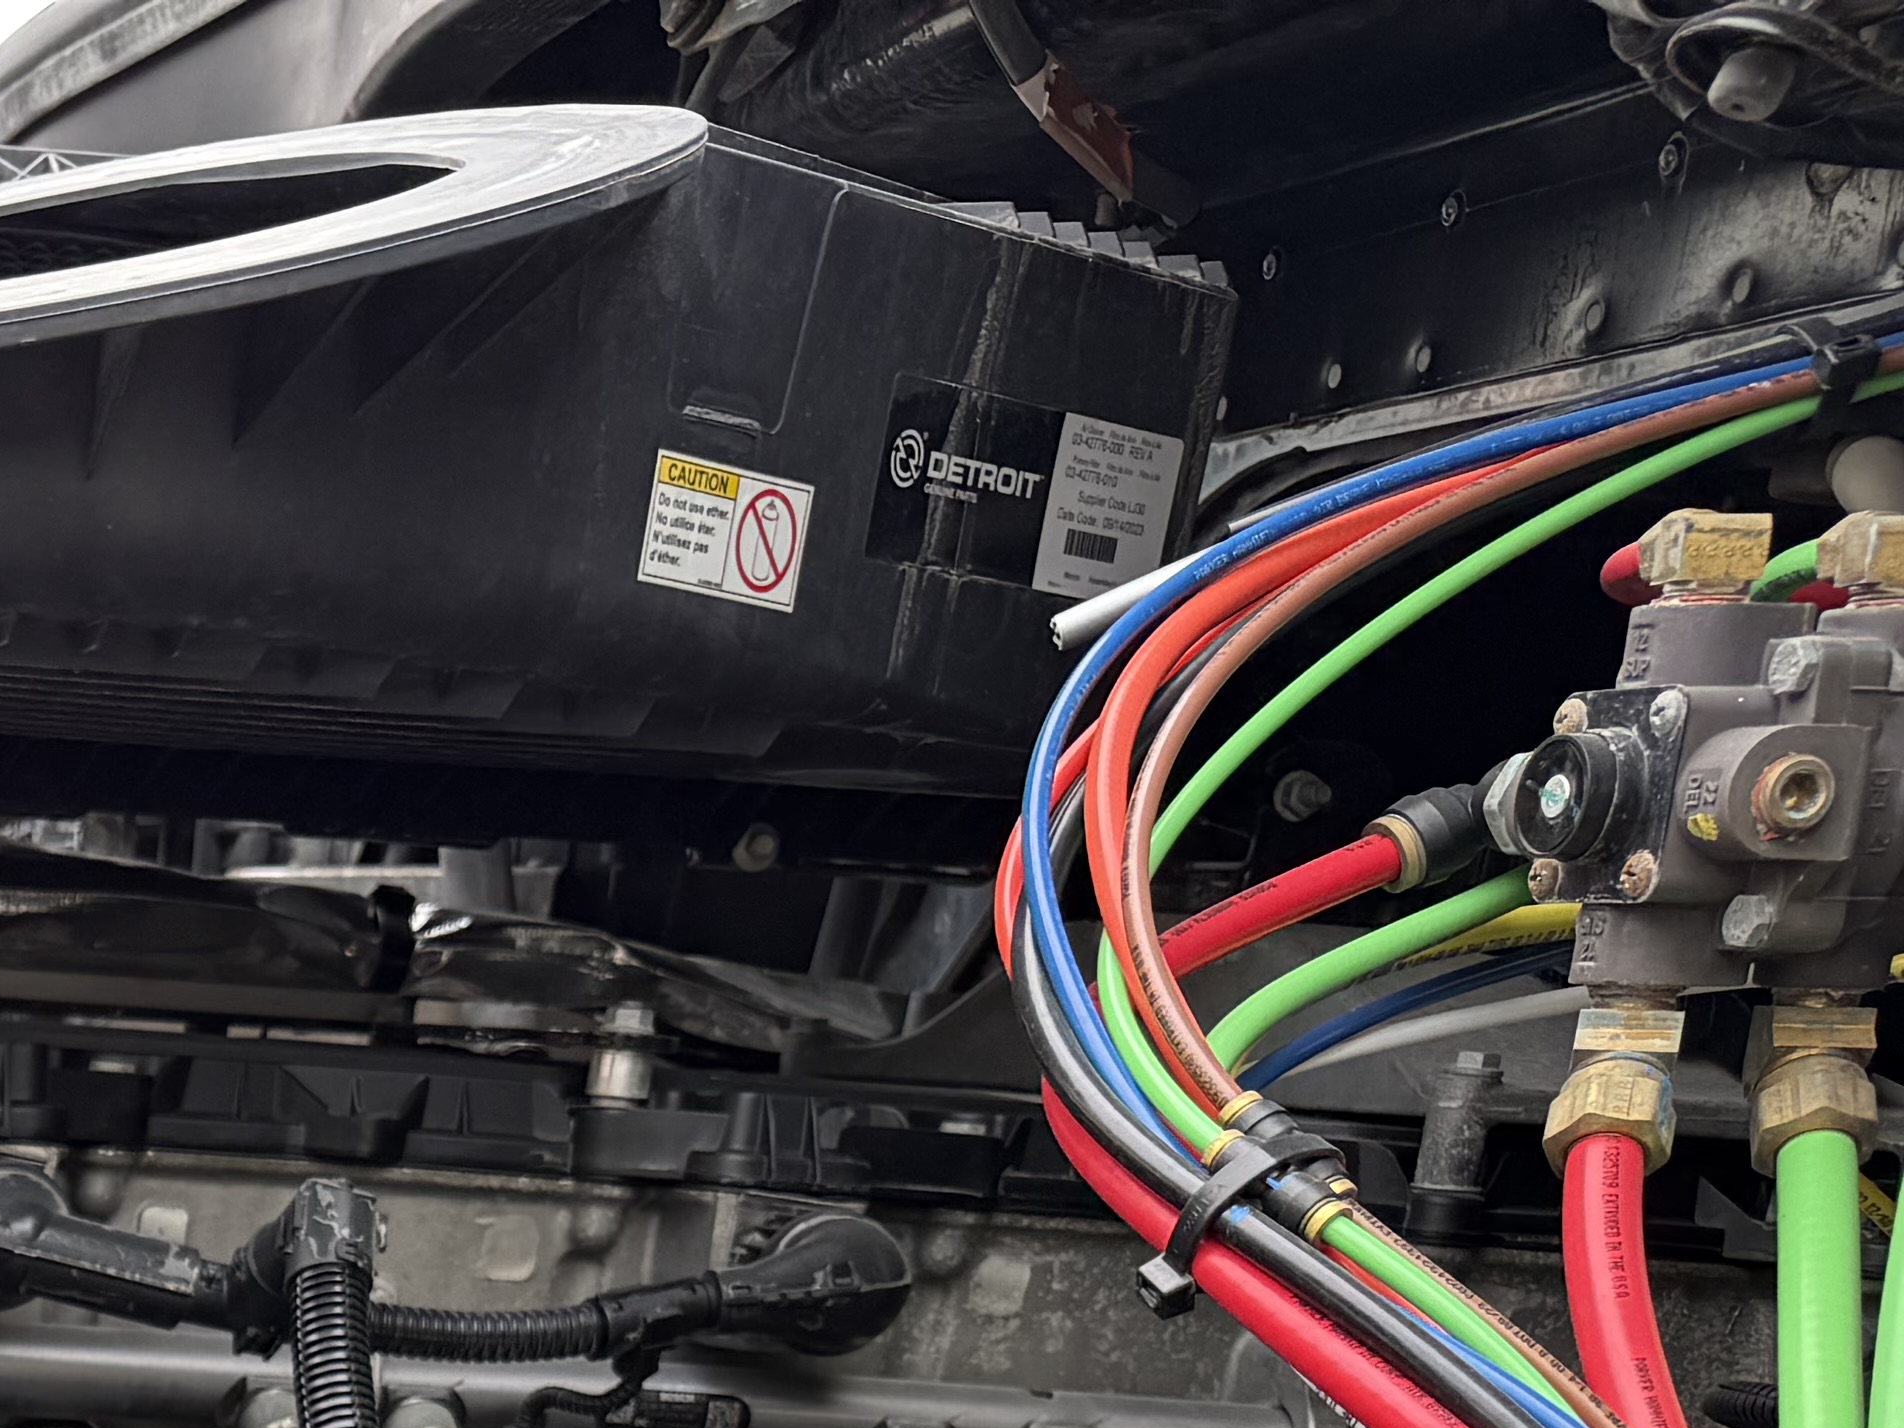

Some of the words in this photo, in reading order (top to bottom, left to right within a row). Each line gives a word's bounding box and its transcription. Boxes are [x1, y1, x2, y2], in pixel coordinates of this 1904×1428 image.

[668, 463, 729, 494] CAUTION
[926, 450, 1041, 499] DETROIT
[672, 495, 687, 511] not
[688, 502, 705, 515] use
